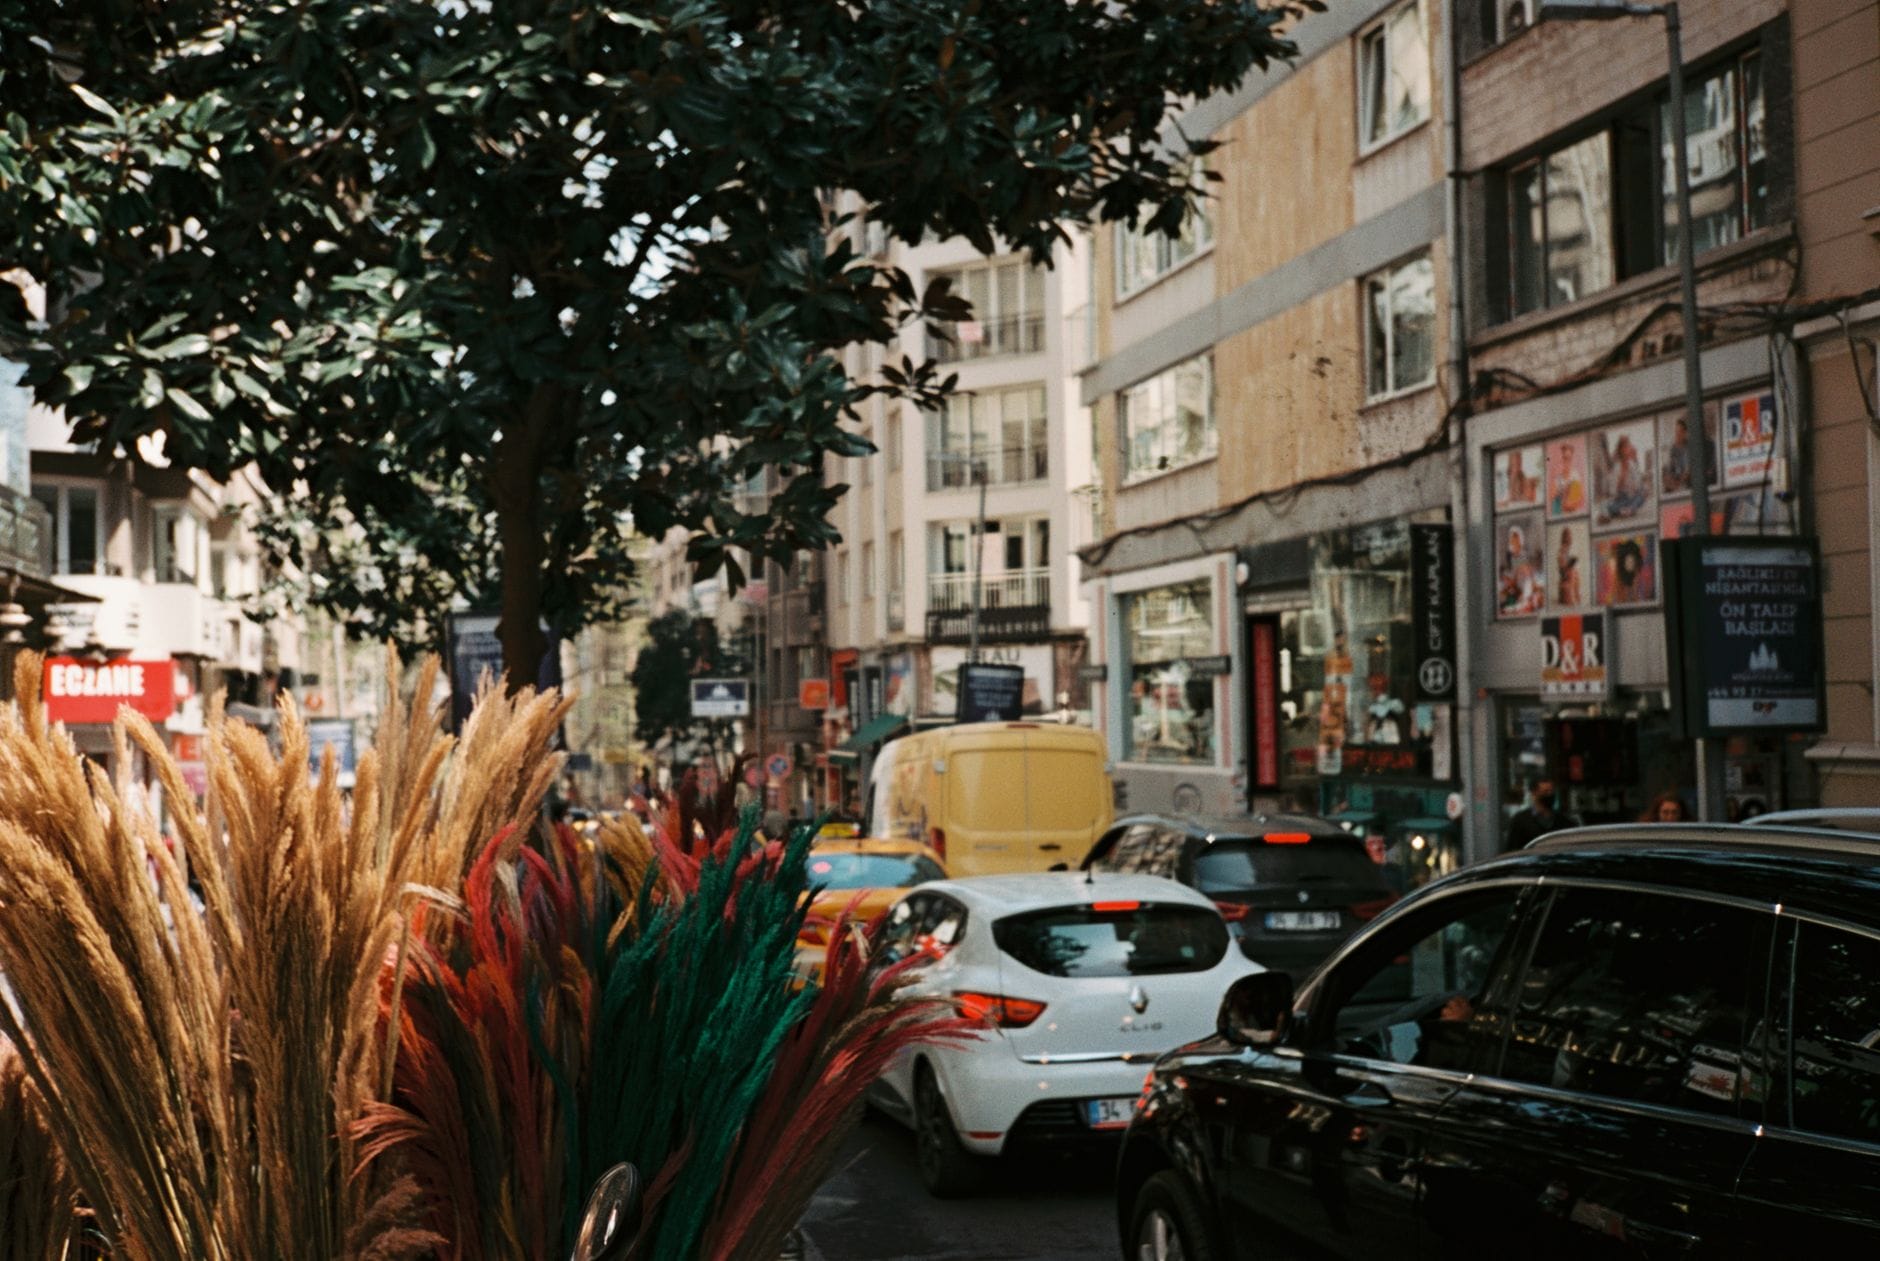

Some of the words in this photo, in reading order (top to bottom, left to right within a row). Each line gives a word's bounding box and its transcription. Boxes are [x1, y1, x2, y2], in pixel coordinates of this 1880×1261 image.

[1727, 410, 1772, 445] D&R
[1720, 602, 1746, 618] ÖN
[1541, 633, 1600, 676] D&R
[50, 663, 145, 696] ECZANE
[1101, 1101, 1121, 1121] 34
